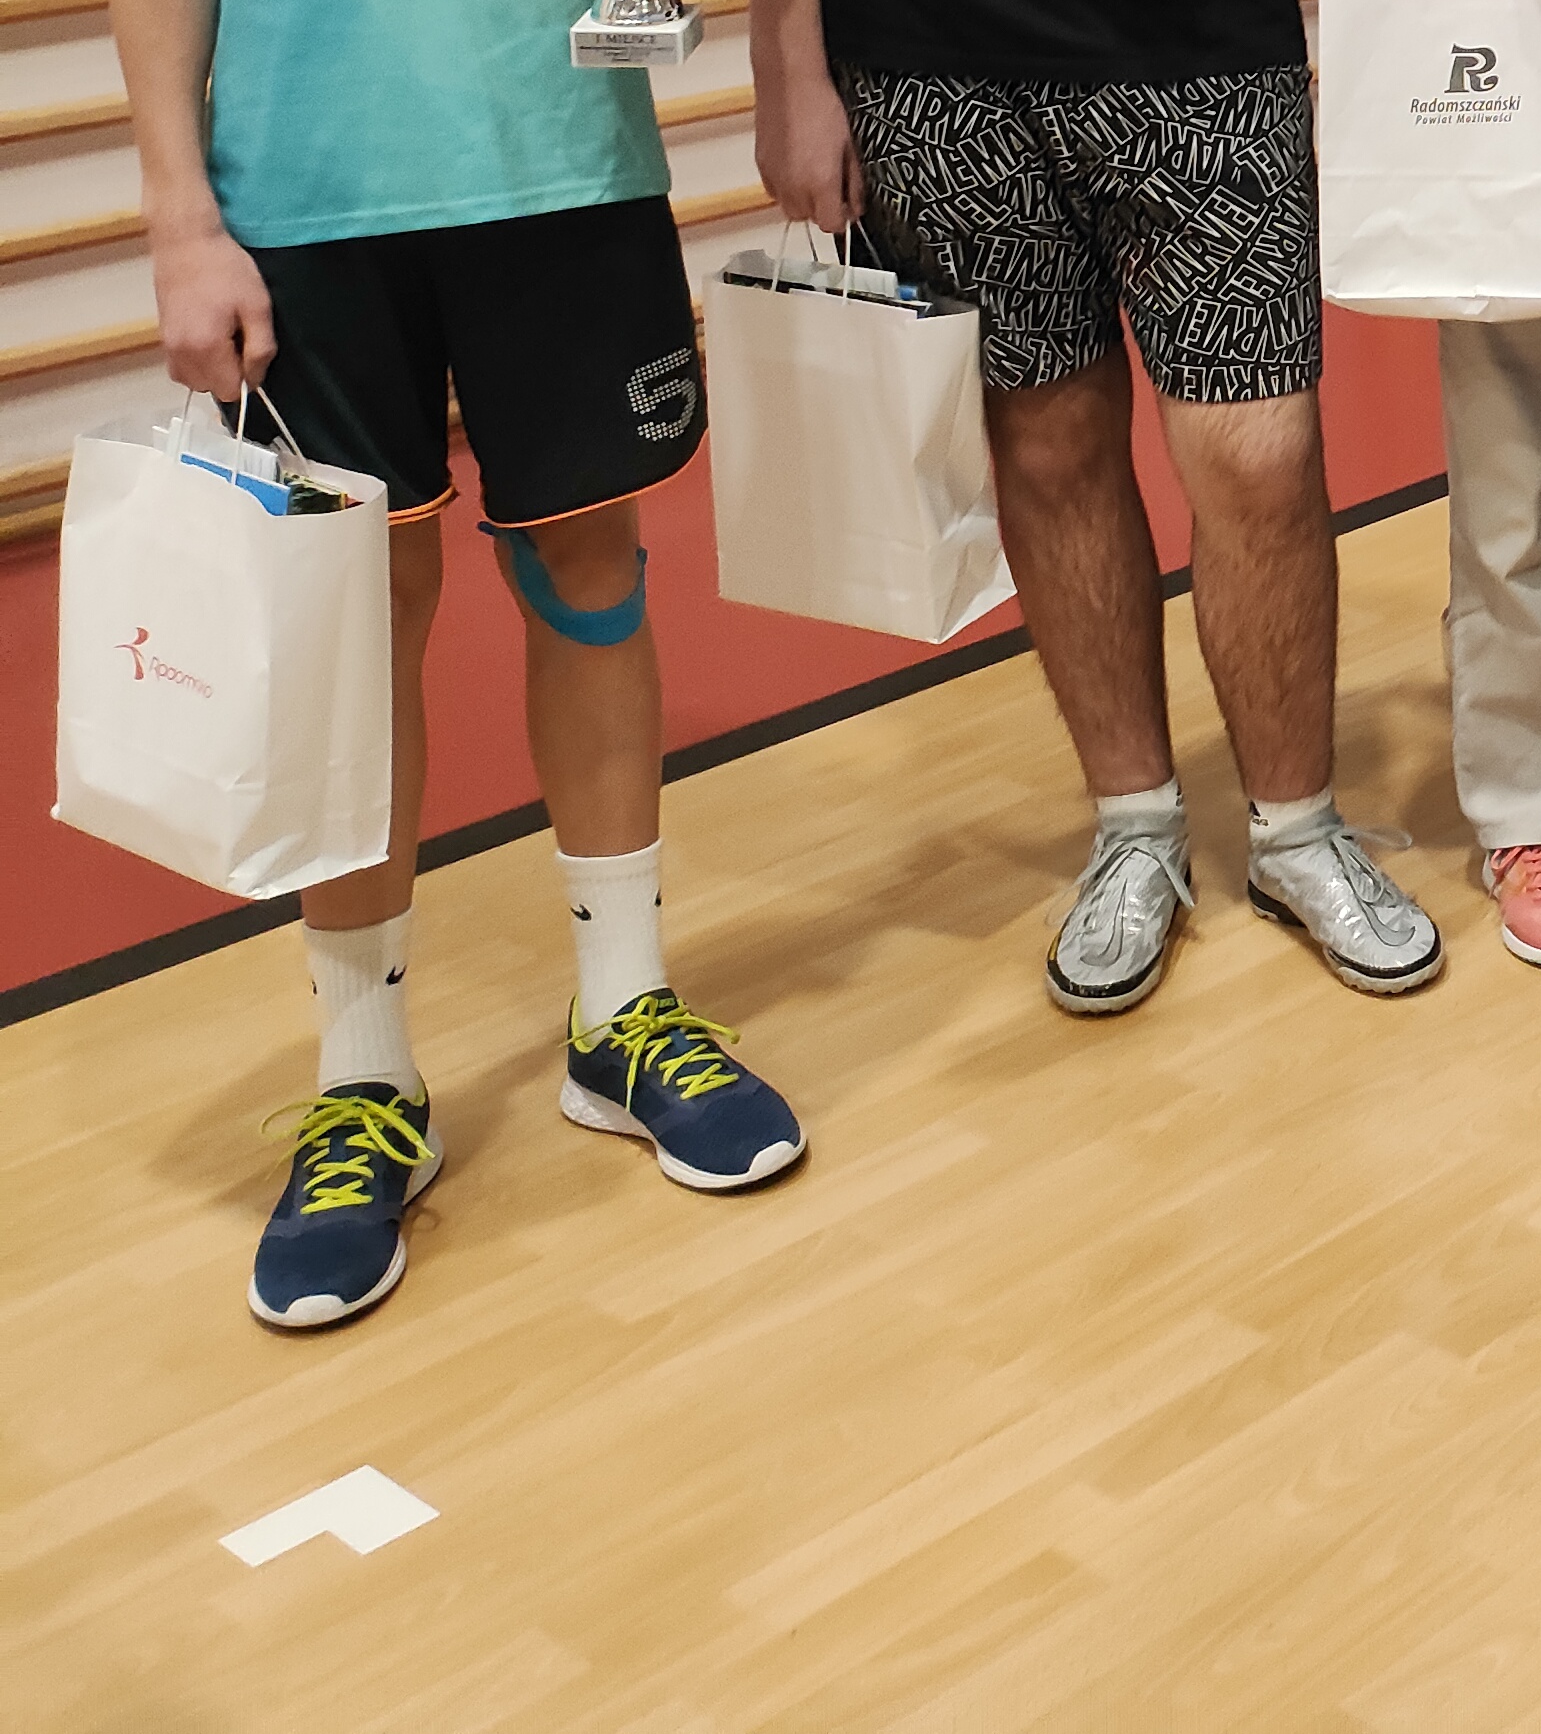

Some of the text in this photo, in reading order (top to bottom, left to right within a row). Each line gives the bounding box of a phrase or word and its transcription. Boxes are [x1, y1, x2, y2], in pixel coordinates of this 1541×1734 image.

[1410, 96, 1521, 114] Radomszczański
[1415, 114, 1453, 126] Powiat
[1150, 184, 1270, 316] MARVEL
